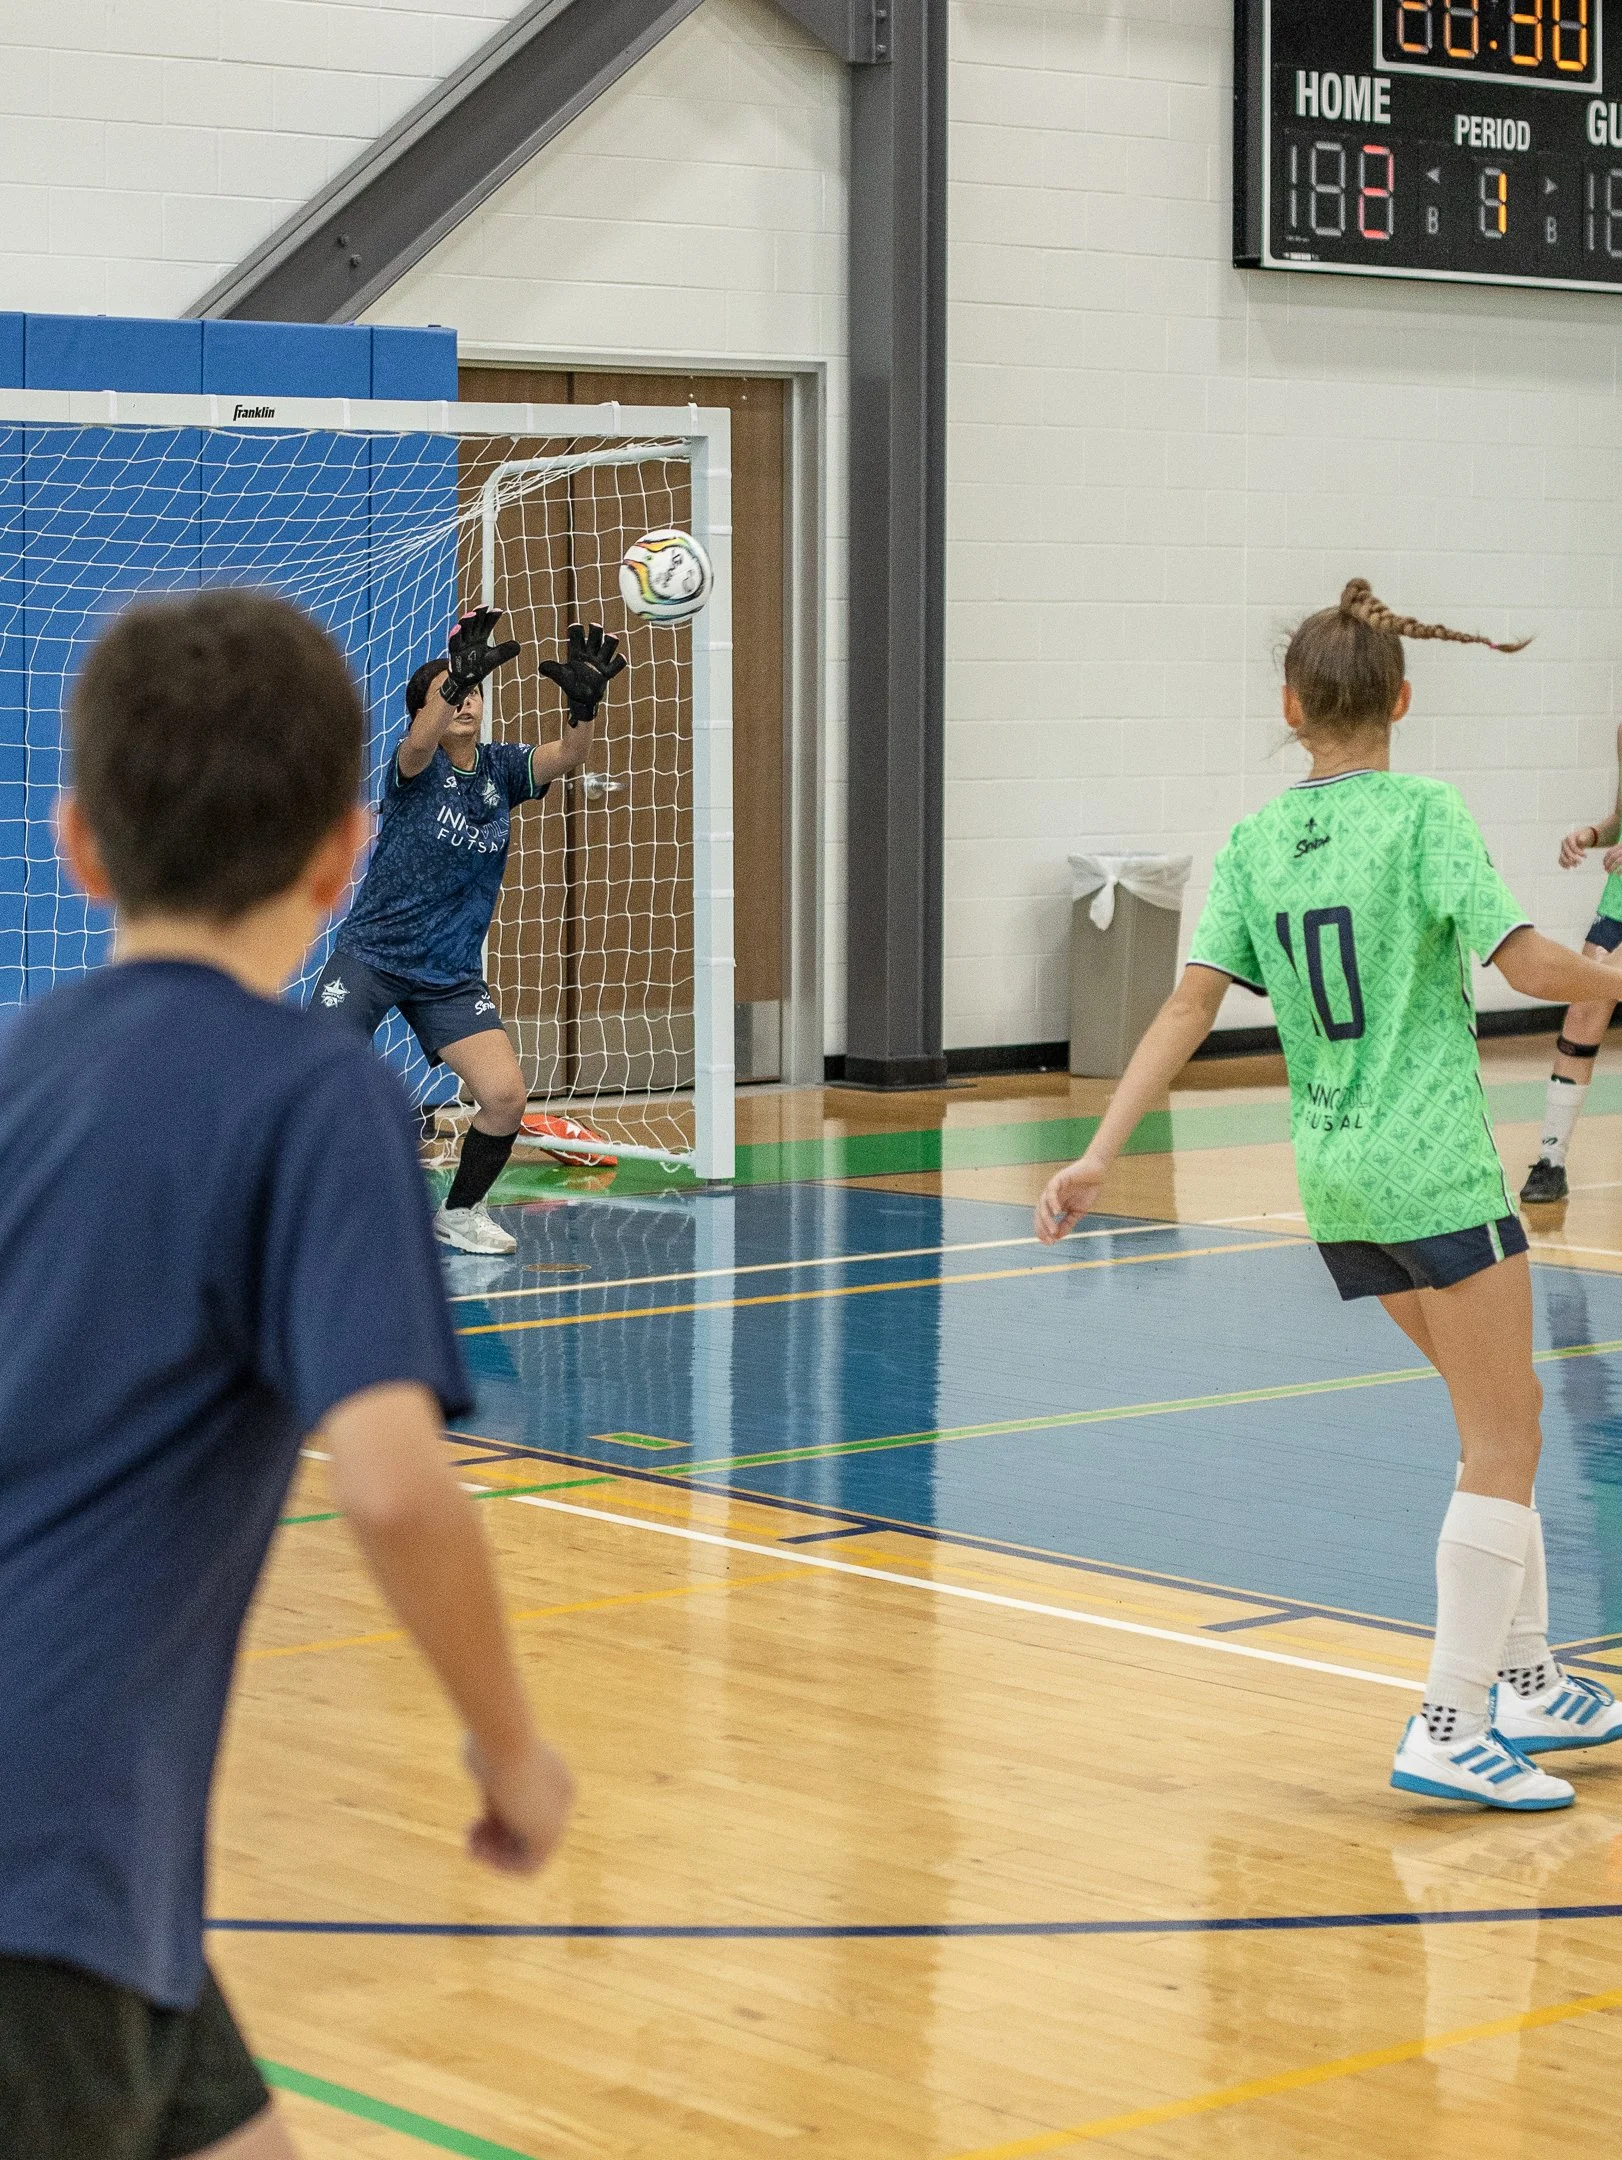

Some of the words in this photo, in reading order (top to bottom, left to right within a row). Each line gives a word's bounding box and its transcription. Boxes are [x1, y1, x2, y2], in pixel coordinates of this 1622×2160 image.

[1296, 70, 1391, 124] HOME
[1455, 114, 1531, 152] PERIOD
[1427, 206, 1440, 236] B
[1546, 216, 1558, 244] B
[1275, 905, 1366, 1042] 10
